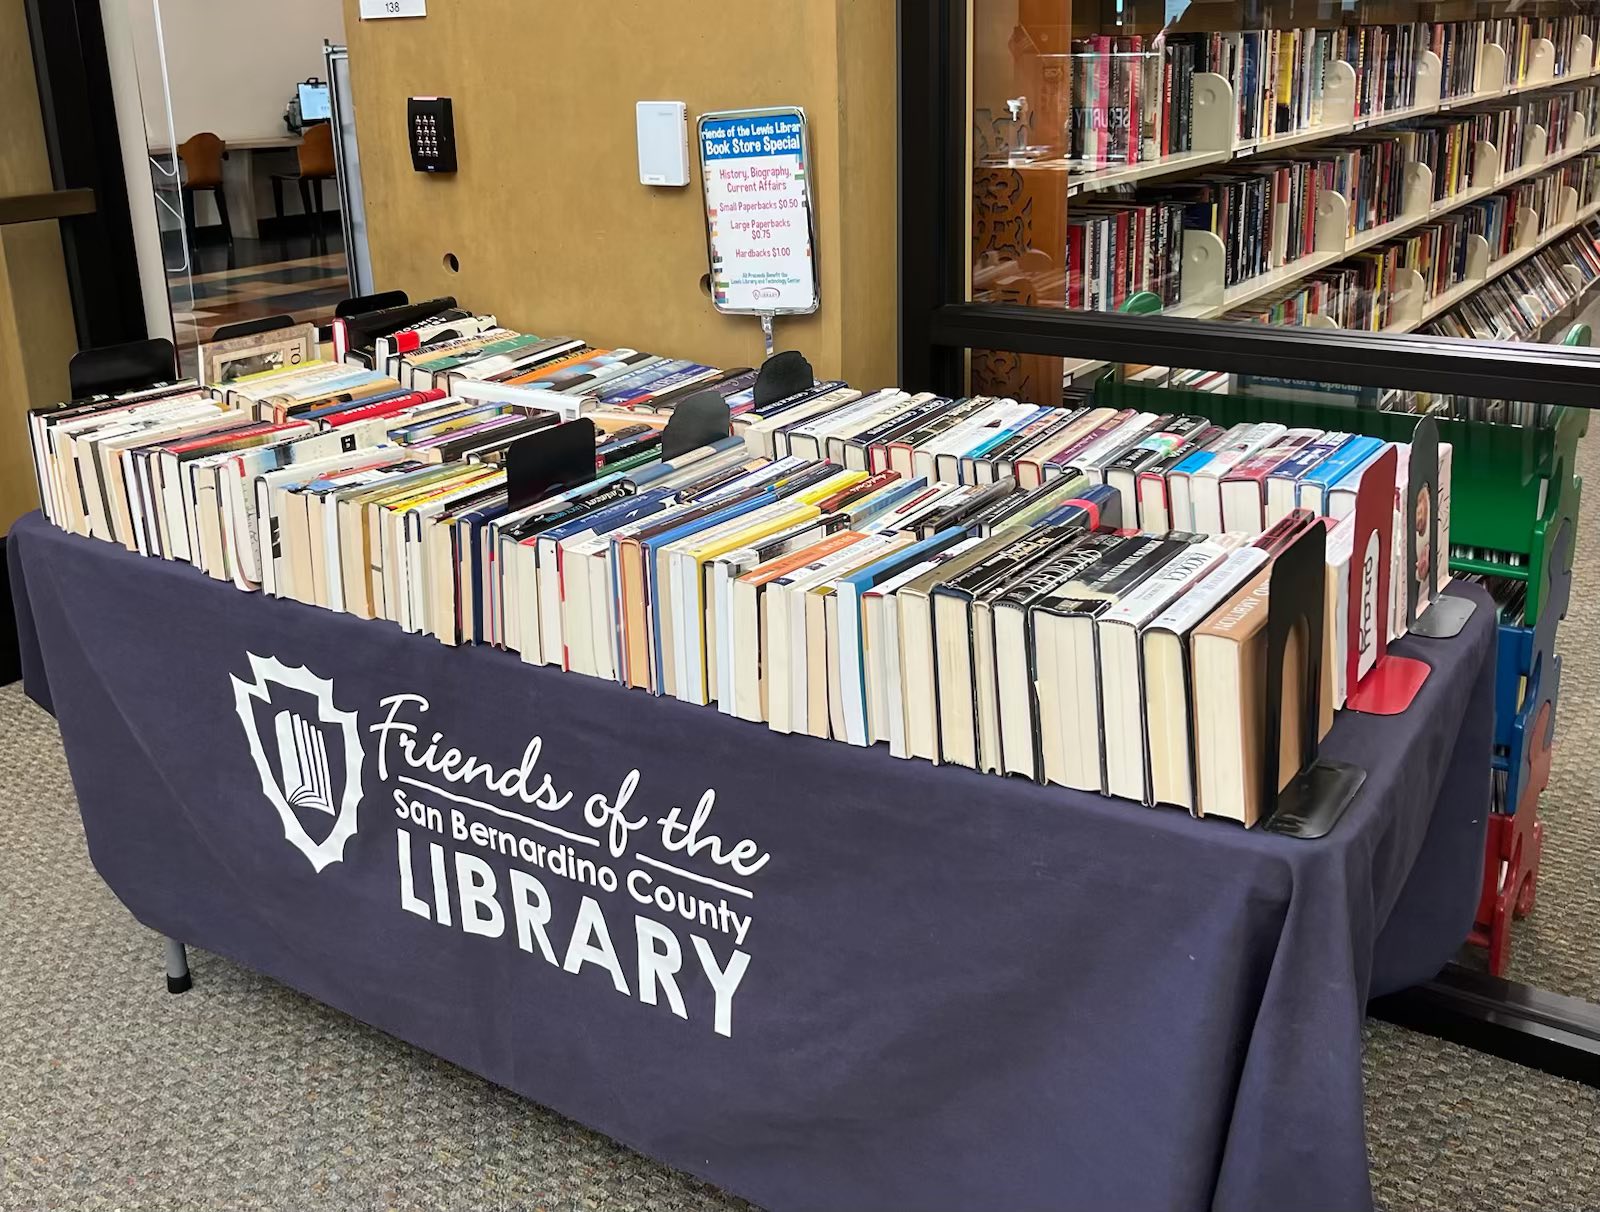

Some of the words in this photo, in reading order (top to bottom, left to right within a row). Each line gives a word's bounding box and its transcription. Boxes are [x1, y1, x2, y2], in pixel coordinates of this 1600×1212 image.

[385, 1, 400, 13] 138
[701, 127, 726, 140] riends
[726, 125, 736, 137] of
[737, 124, 750, 137] the
[750, 123, 774, 136] Lewis
[774, 121, 800, 134] Librar
[705, 140, 731, 155] Book
[732, 138, 761, 154] Store
[763, 134, 800, 155] Special
[719, 168, 750, 181] History,
[750, 166, 792, 180] Biography,
[726, 182, 757, 193] Current
[758, 180, 787, 192] Affairs
[719, 202, 737, 213] Small
[738, 200, 777, 213] Paperbacks
[778, 198, 799, 210] $0.50
[730, 220, 750, 232] Large
[751, 218, 791, 230] Paperbacks
[751, 229, 771, 240] $0.75
[735, 248, 771, 258] Hardbacks
[771, 247, 791, 258] $1.00
[369, 693, 574, 812] Friends
[583, 768, 649, 858] of
[656, 788, 771, 877] the
[393, 789, 444, 834] San
[450, 807, 619, 893] Bernardino
[625, 868, 753, 946] County
[396, 827, 752, 1039] LIBRARY
